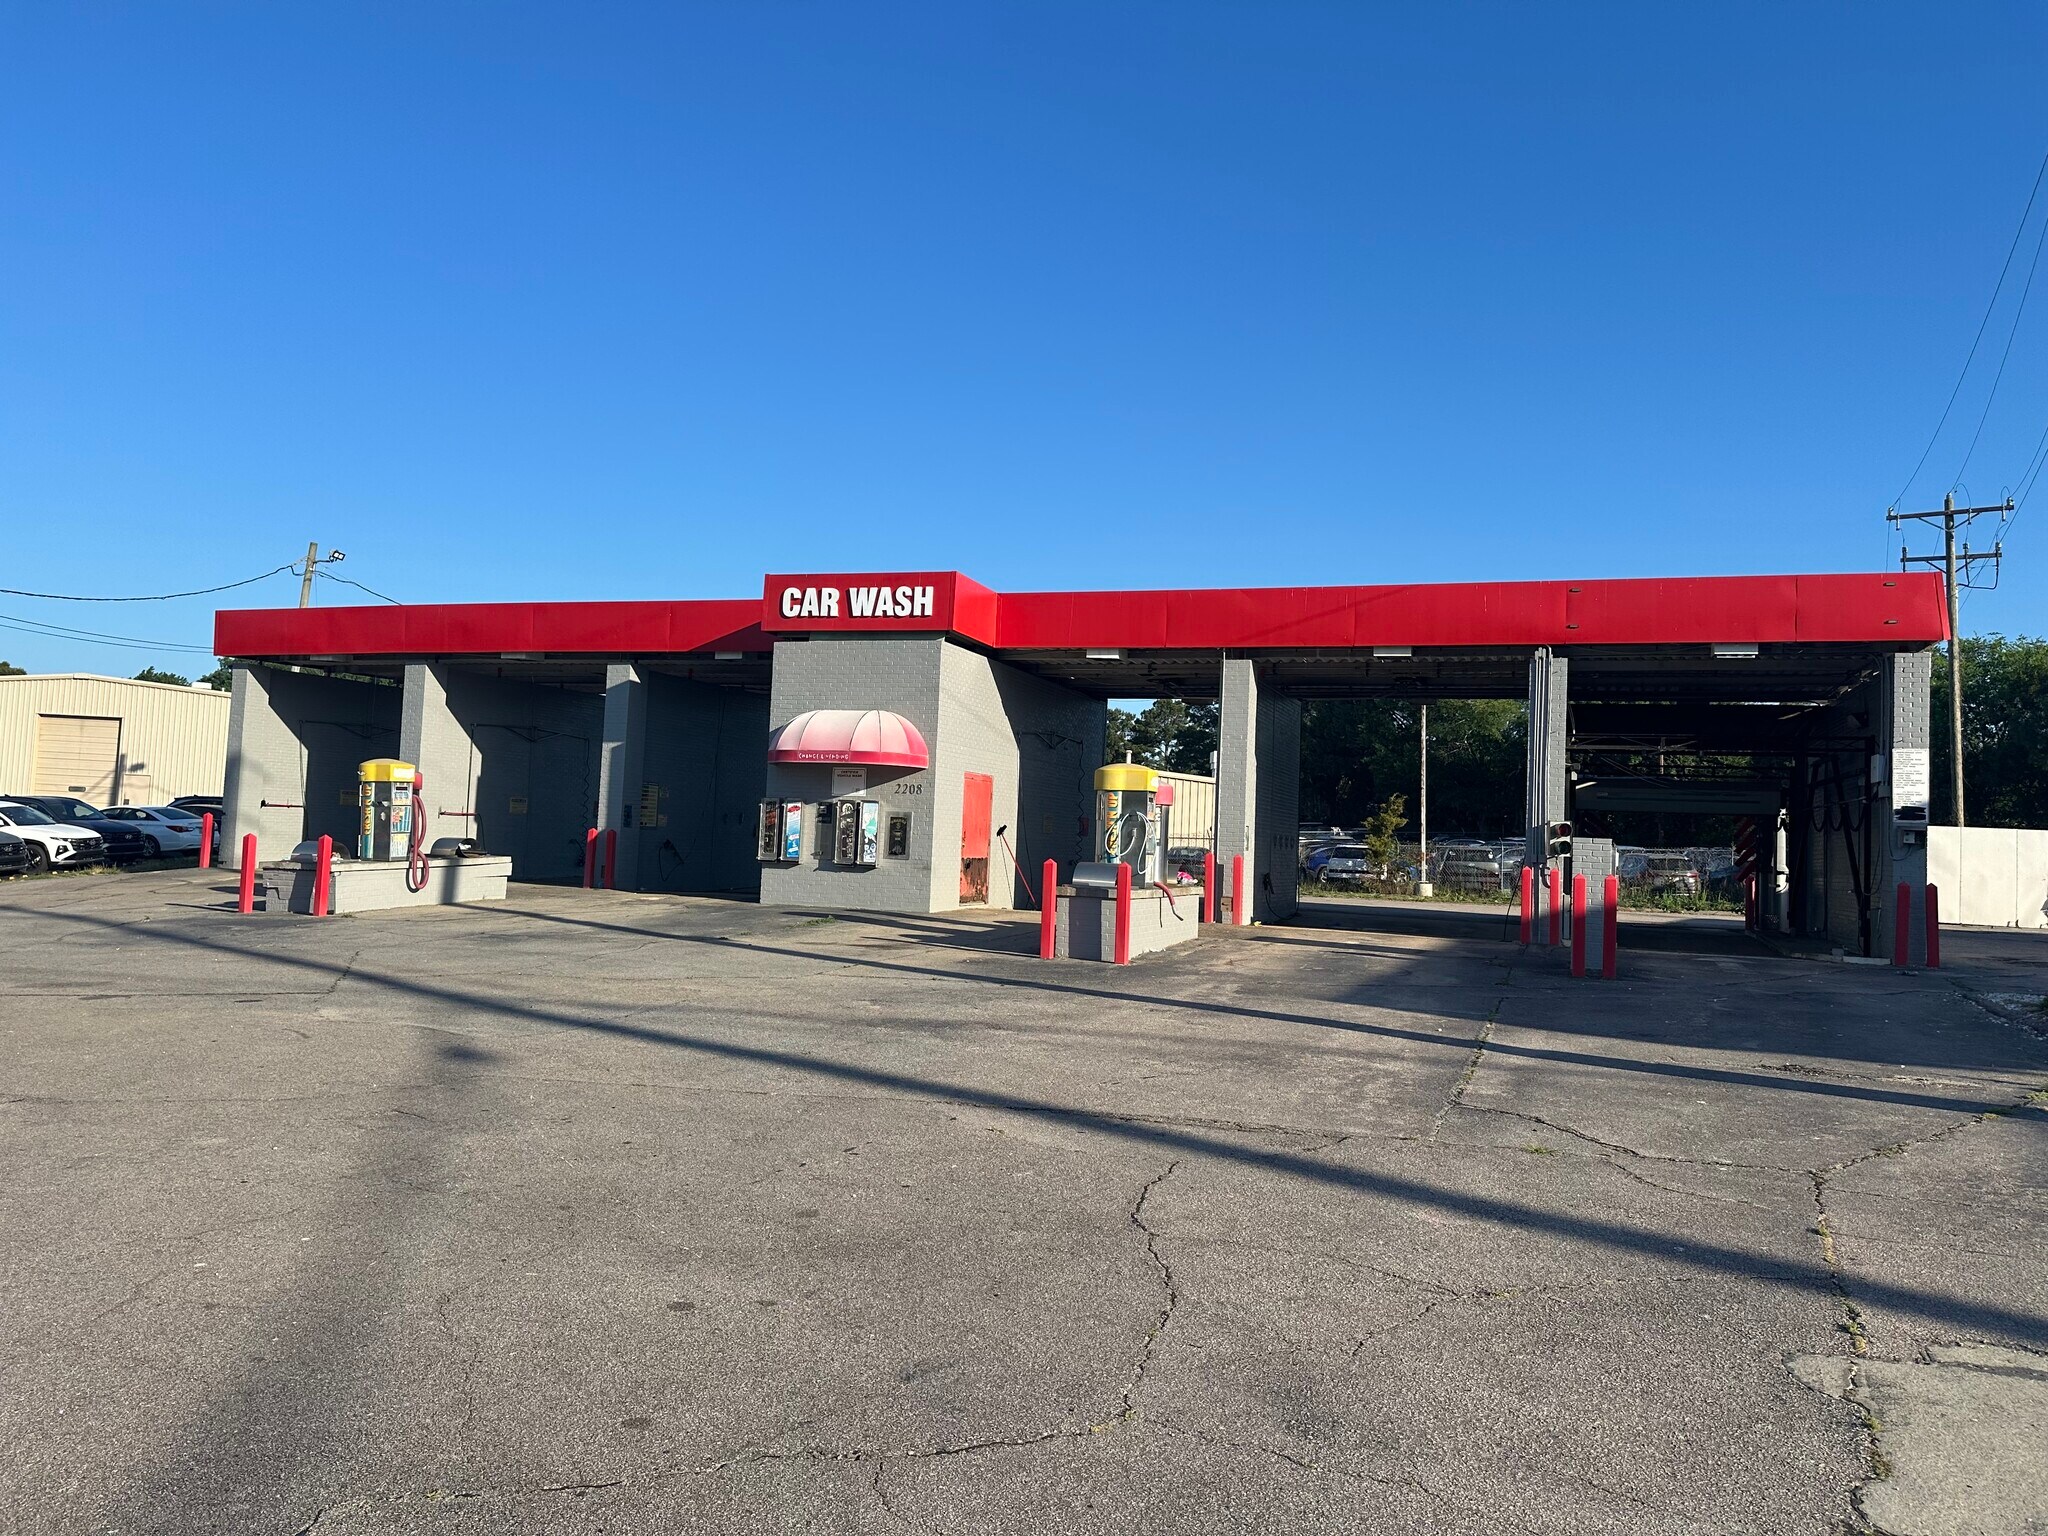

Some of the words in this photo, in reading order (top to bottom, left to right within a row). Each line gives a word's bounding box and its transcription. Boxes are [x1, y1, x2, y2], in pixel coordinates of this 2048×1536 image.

[781, 587, 840, 617] CAR
[848, 586, 934, 617] WASH
[363, 784, 372, 796] UP
[894, 783, 923, 795] 2208
[1107, 792, 1118, 808] UP
